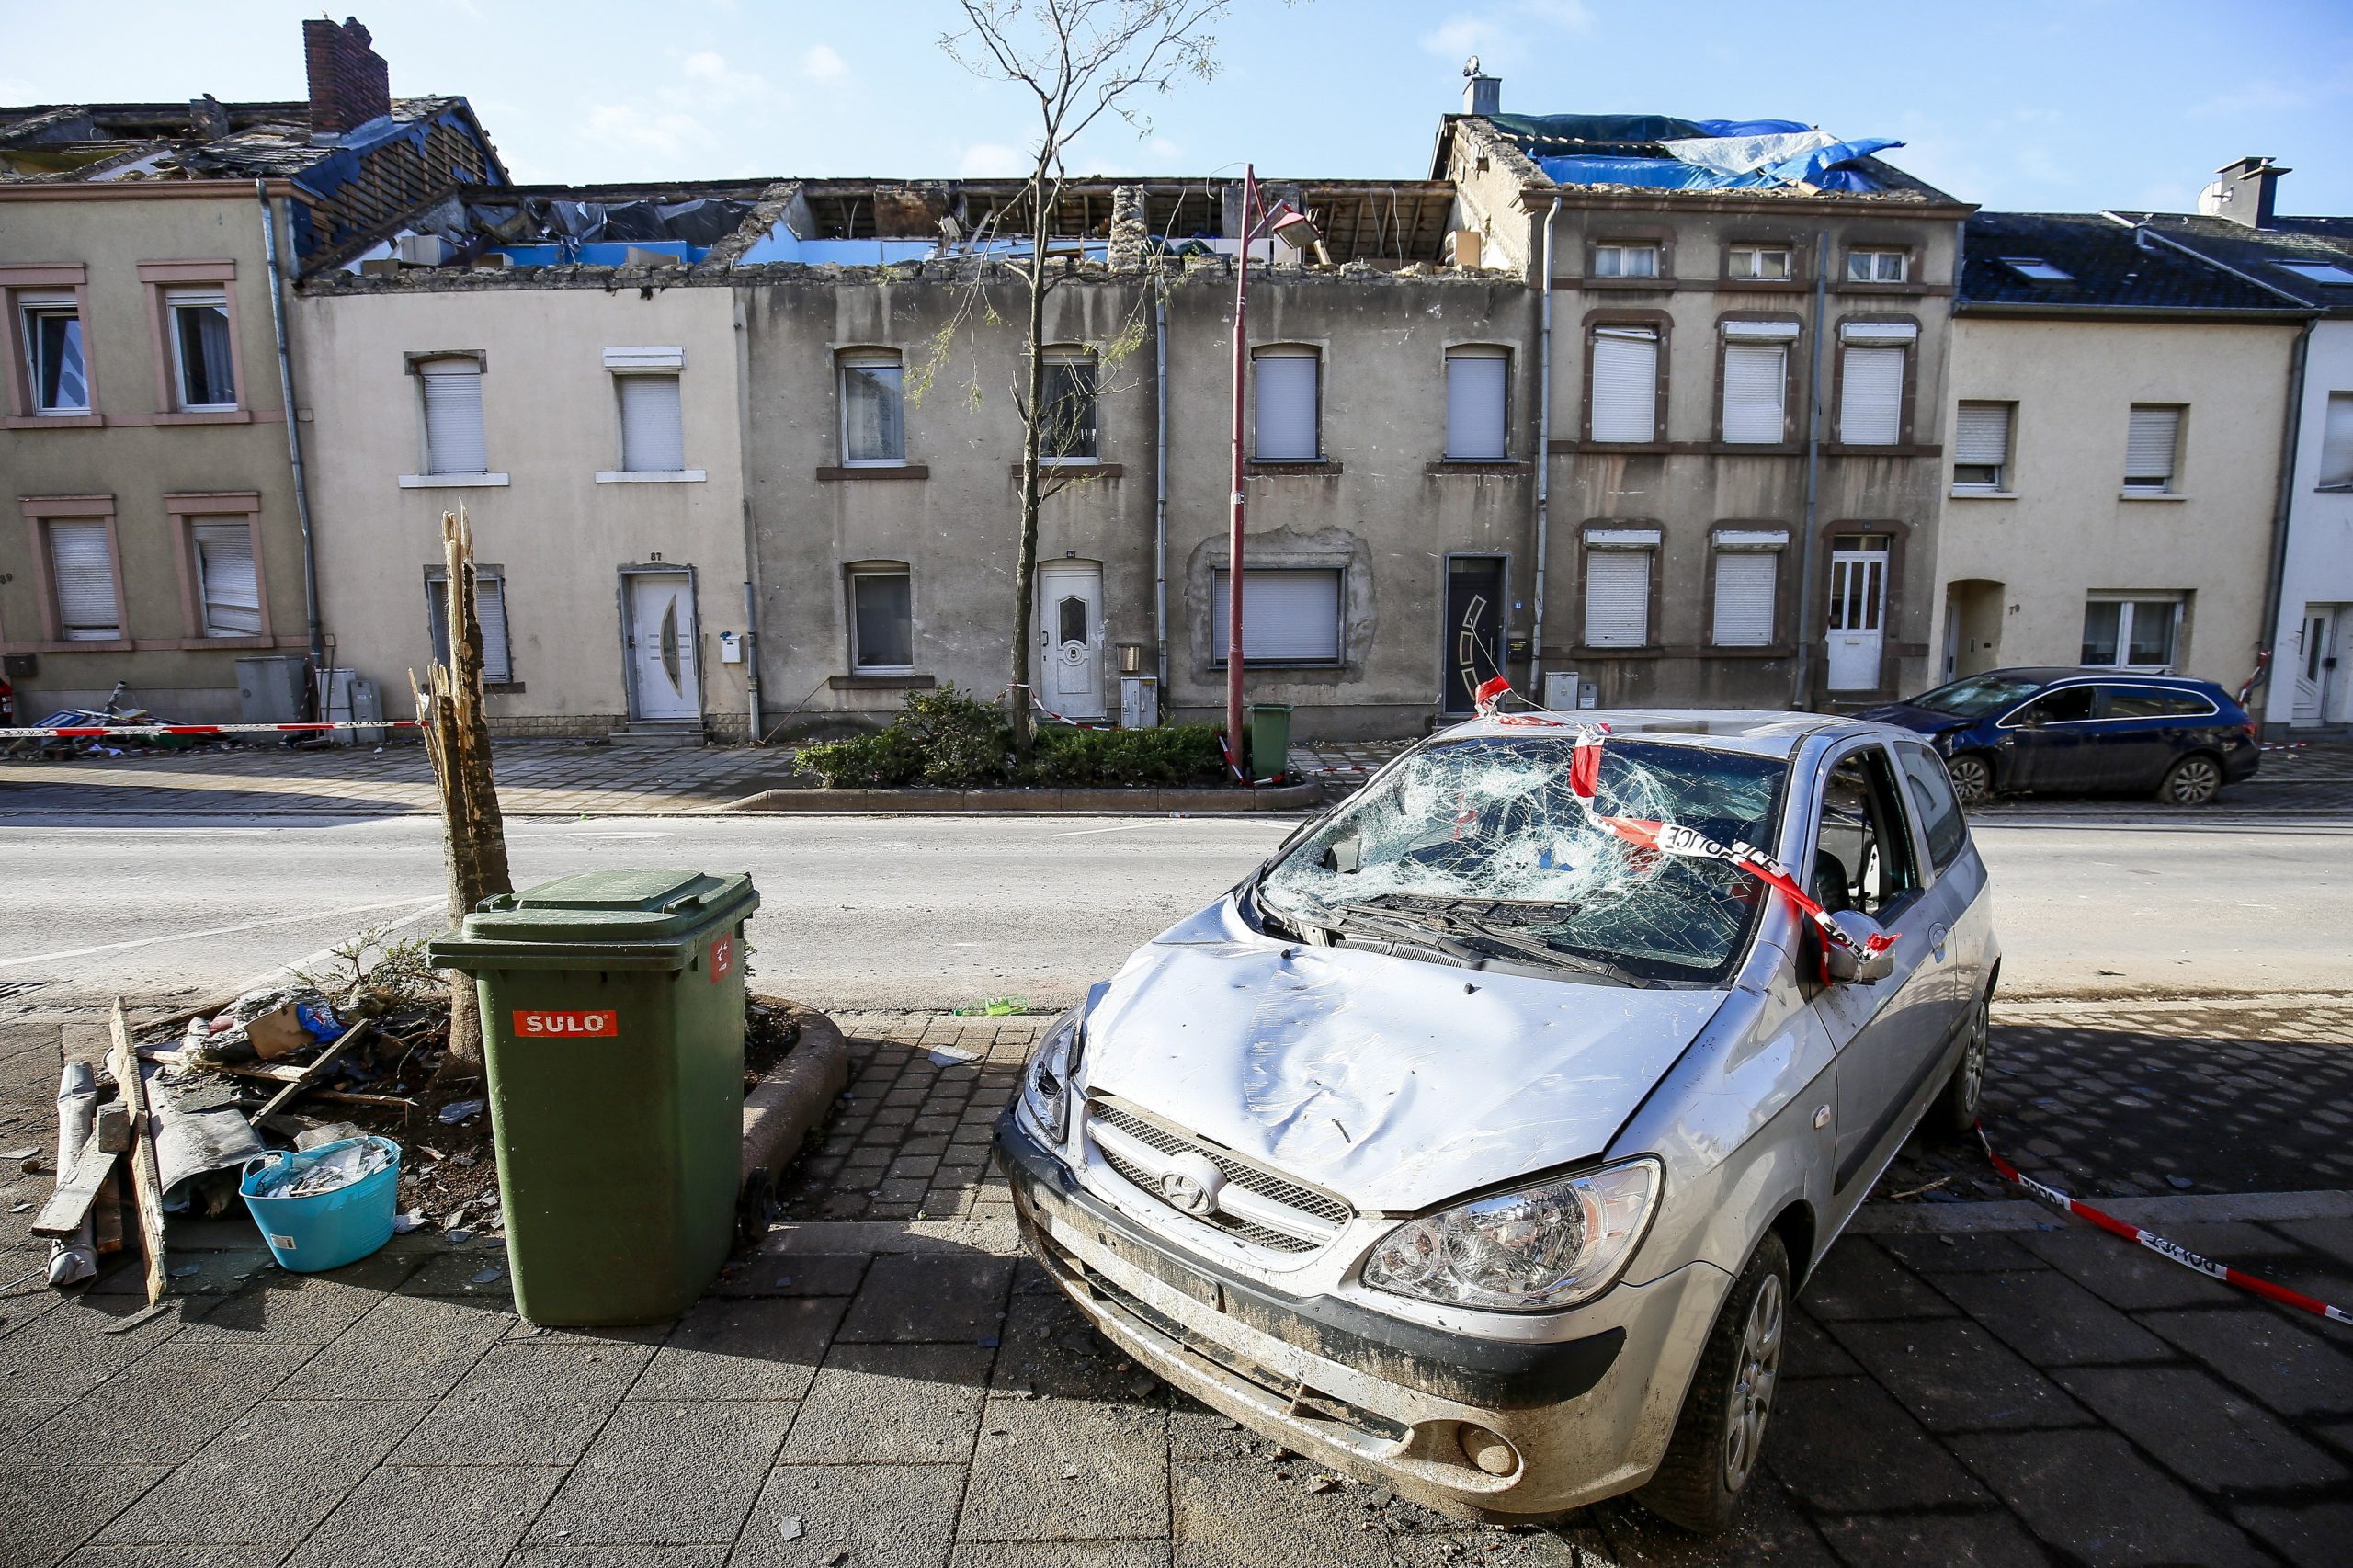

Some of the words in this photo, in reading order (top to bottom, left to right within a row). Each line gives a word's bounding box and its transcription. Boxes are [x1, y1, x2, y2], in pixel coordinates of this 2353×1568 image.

[650, 551, 662, 561] 87
[2009, 603, 2020, 615] 79
[526, 1015, 604, 1032] SULO
